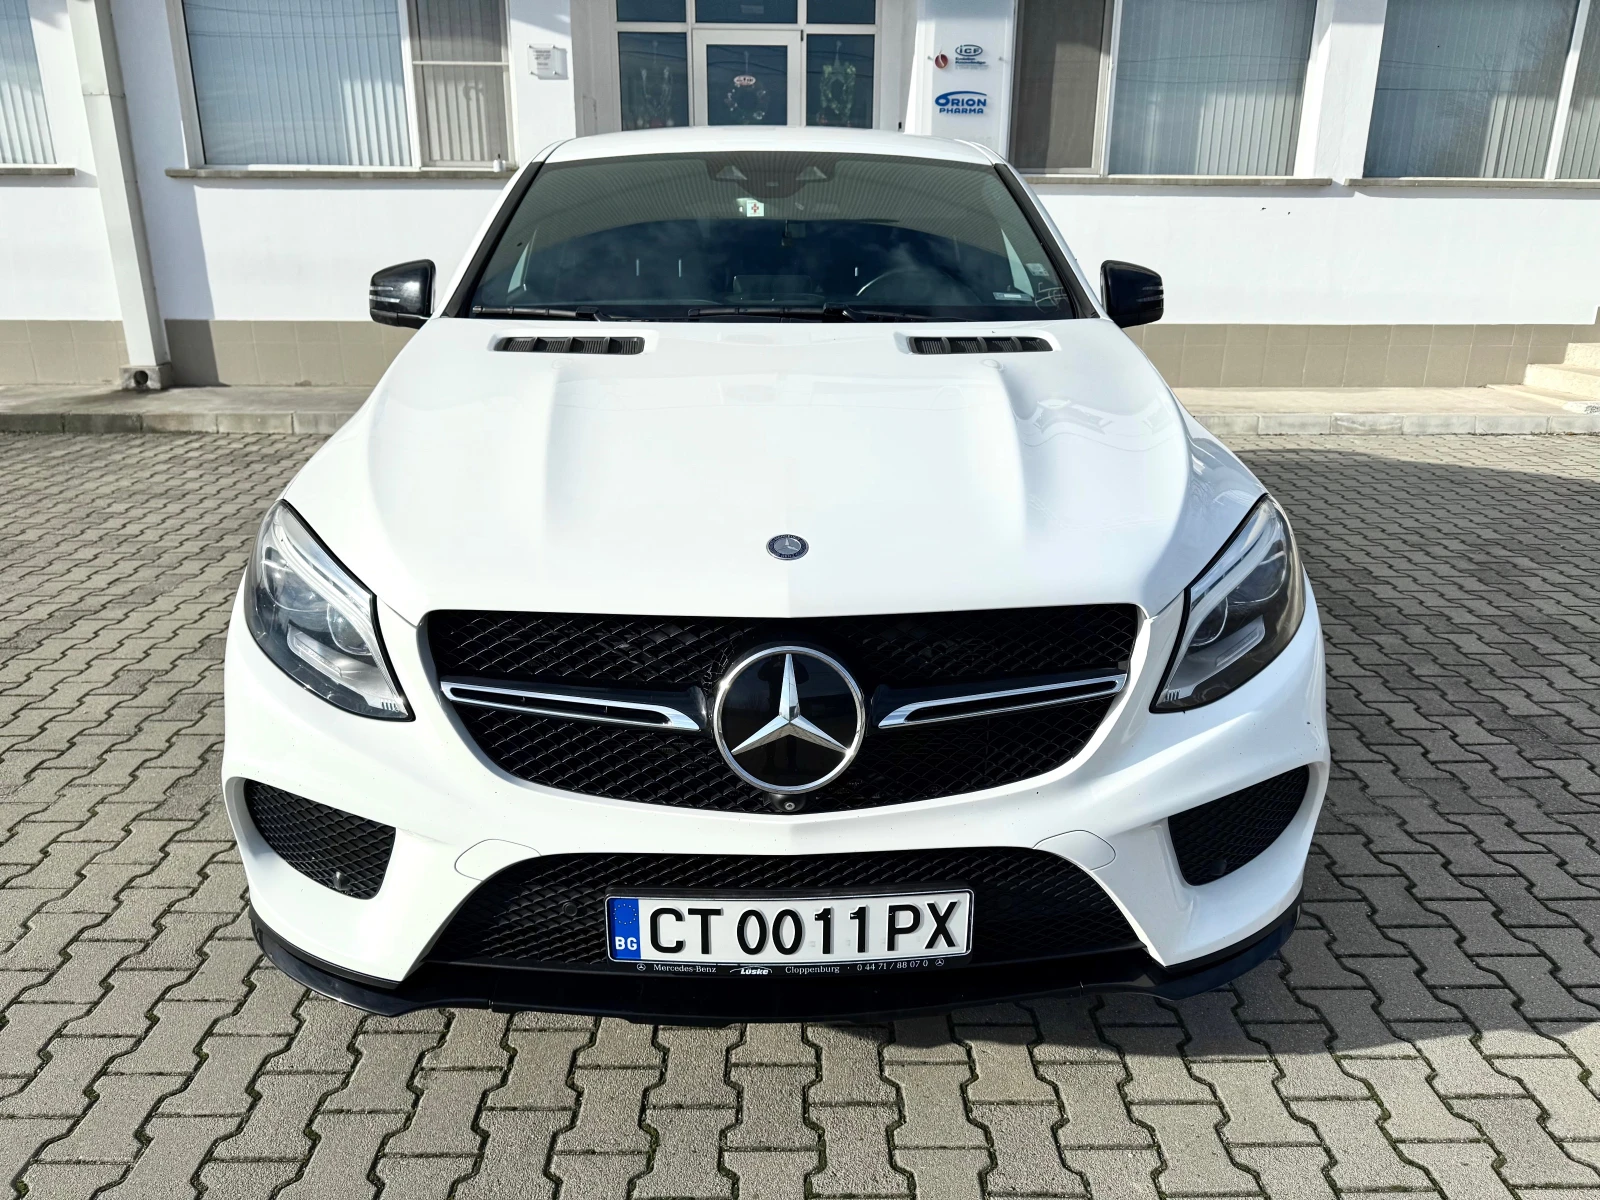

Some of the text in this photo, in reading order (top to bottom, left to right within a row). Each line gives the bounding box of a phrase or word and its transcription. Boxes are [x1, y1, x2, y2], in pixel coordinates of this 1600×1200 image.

[935, 91, 987, 107] ORION
[650, 901, 958, 955] CT 0011 PX
[615, 936, 638, 950] BG
[653, 963, 717, 973] Mercedes-Benz
[785, 966, 840, 974] Cloppenburg
